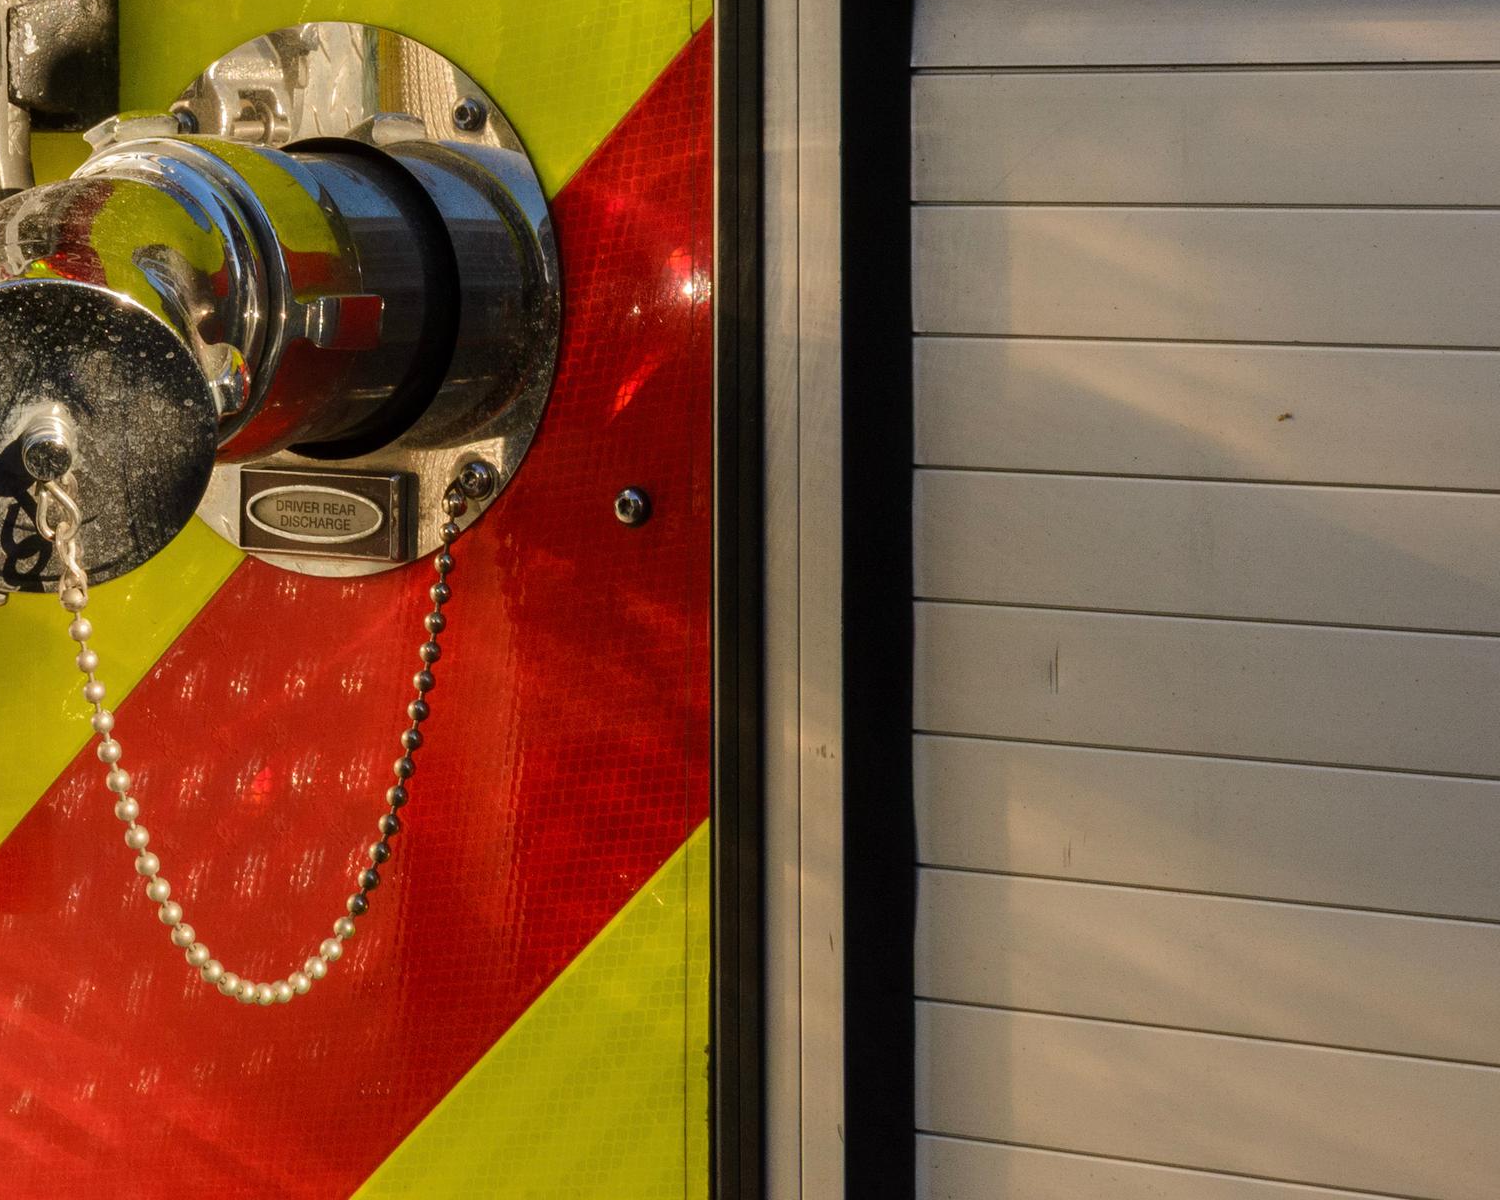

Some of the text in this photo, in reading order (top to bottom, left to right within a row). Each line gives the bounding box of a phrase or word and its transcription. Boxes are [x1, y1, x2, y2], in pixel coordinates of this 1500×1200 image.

[276, 499, 356, 517] DRIVER REAR
[280, 515, 352, 531] DISCHARGE
